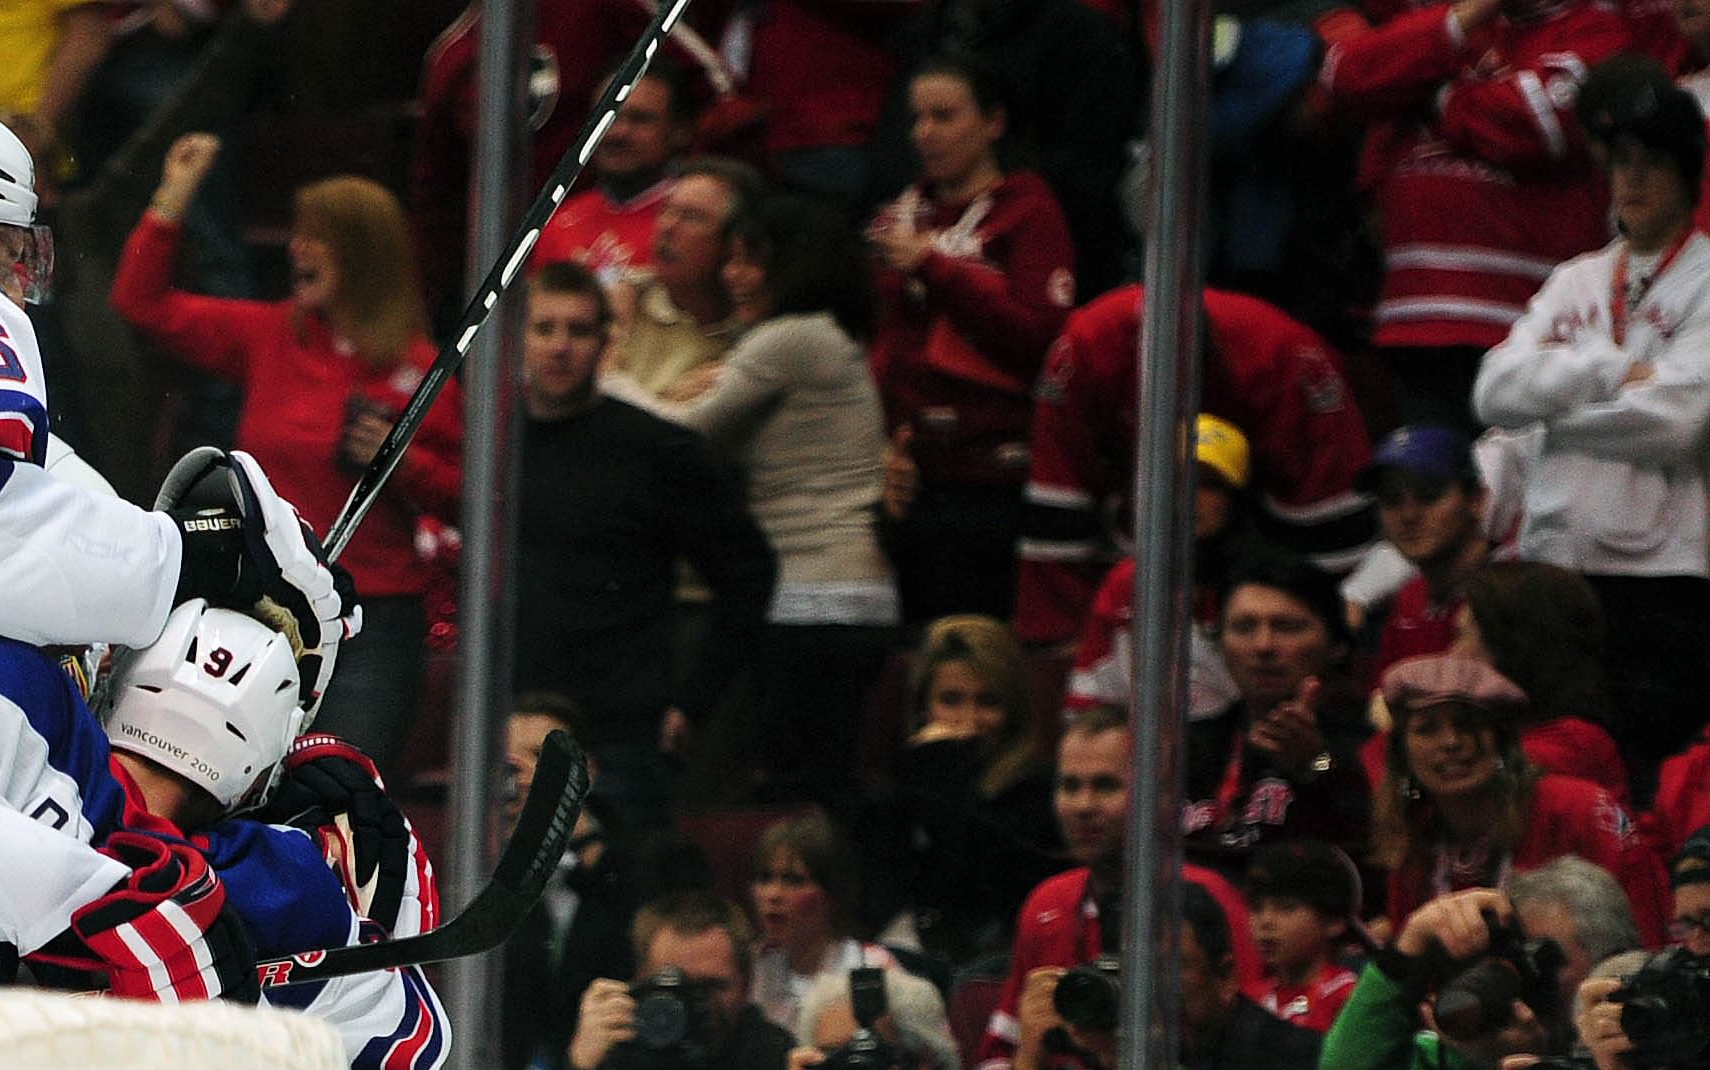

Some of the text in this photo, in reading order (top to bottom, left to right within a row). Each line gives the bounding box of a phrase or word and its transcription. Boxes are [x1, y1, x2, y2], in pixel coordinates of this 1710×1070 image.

[203, 647, 233, 679] 9
[121, 722, 221, 783] vancouver 2010
